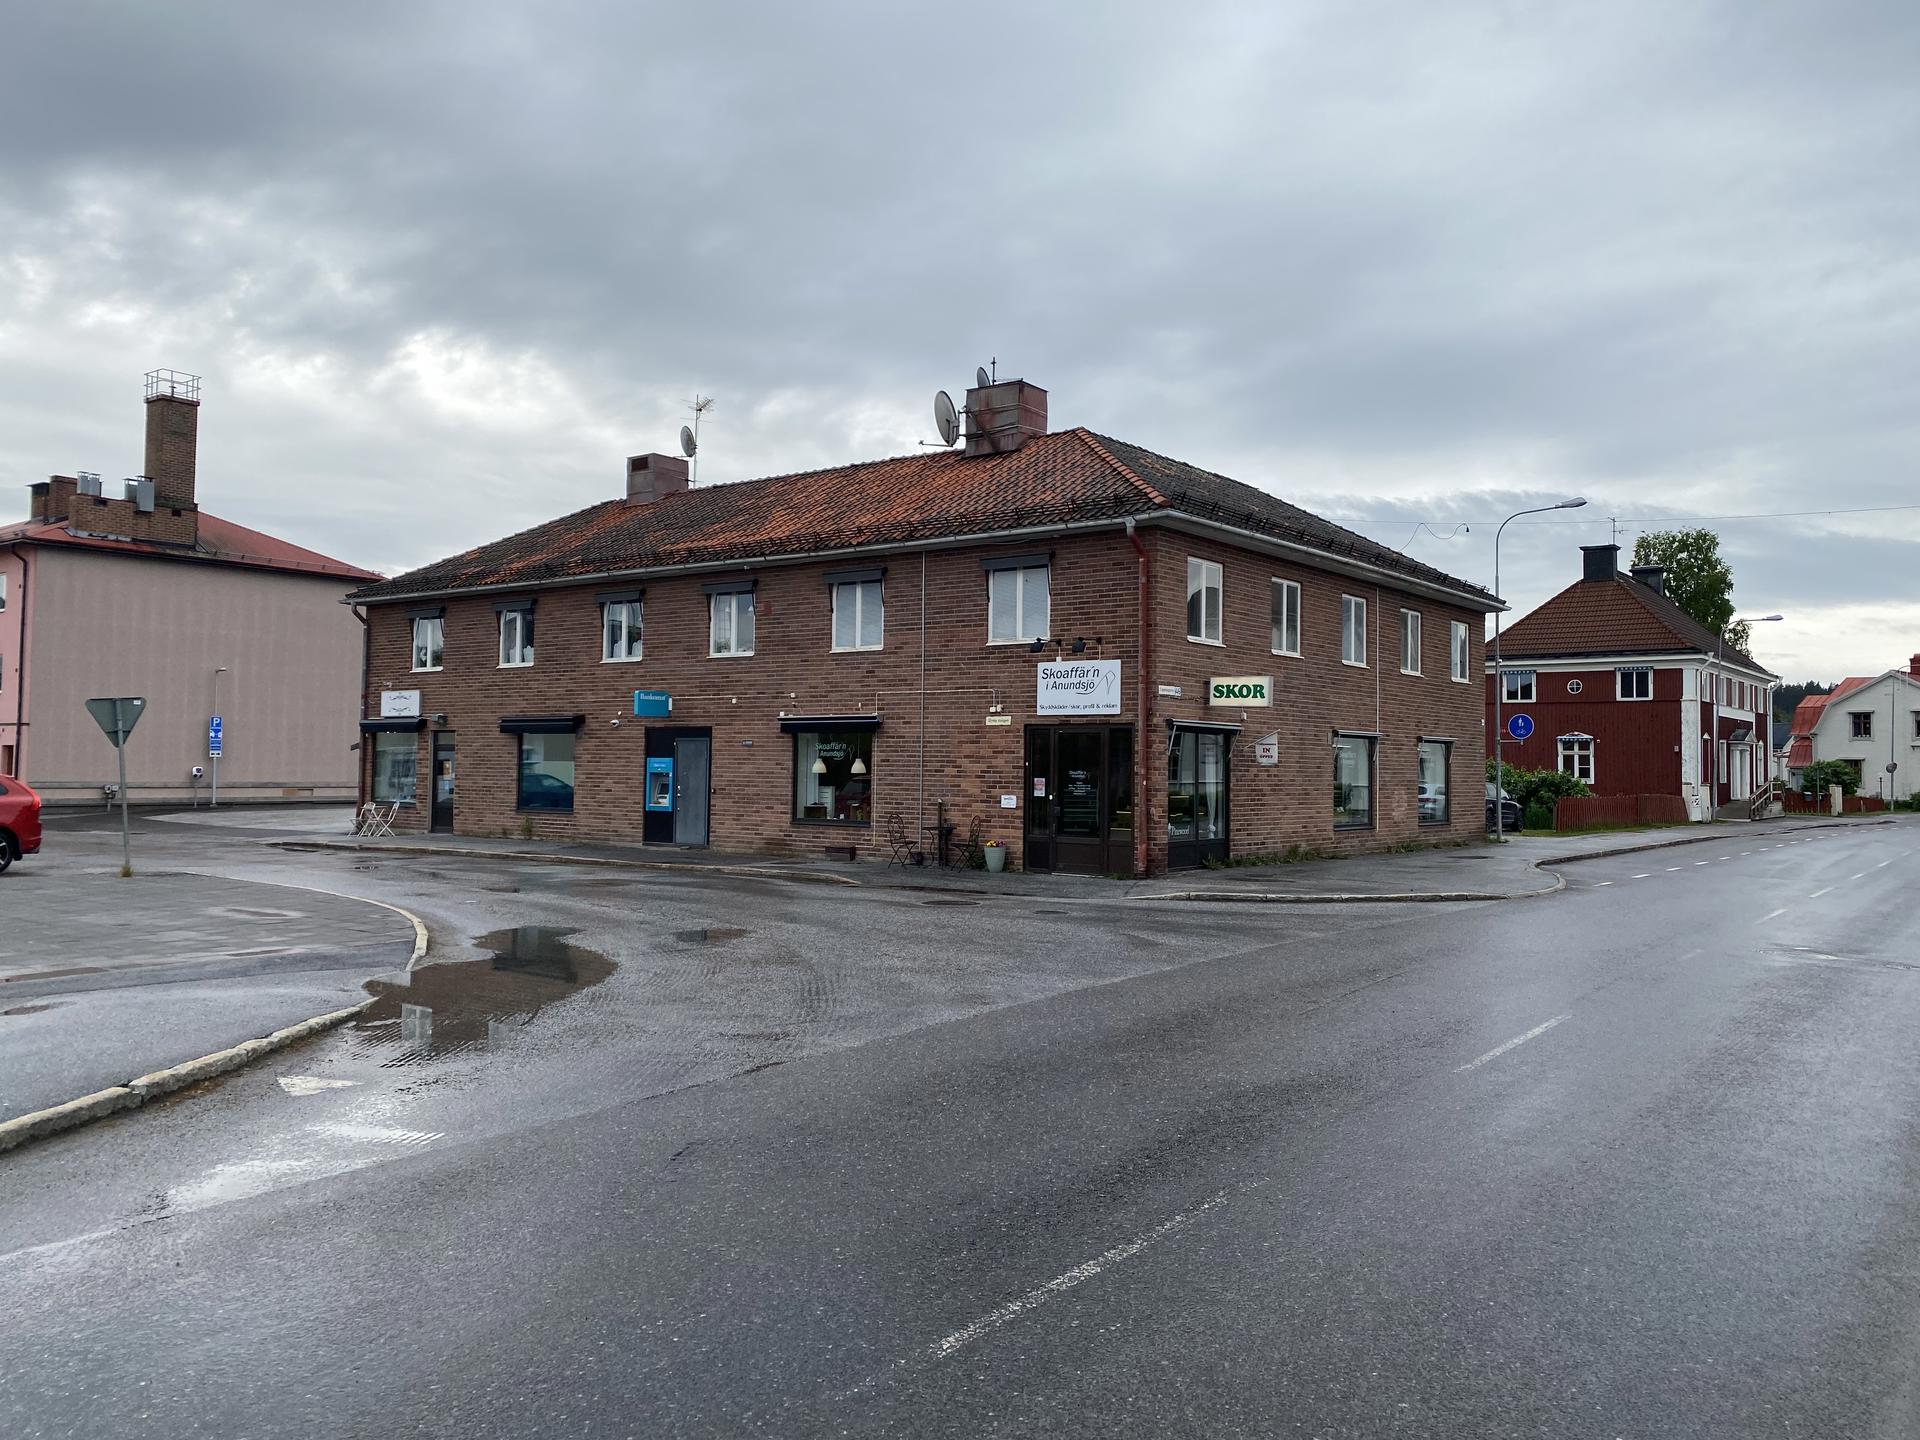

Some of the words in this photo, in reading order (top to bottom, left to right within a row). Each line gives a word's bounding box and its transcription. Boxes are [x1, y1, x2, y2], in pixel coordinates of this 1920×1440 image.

[1046, 681, 1049, 690] i
[1051, 680, 1095, 691] Anundsjö
[1212, 684, 1266, 699] SKOR
[213, 717, 221, 727] P
